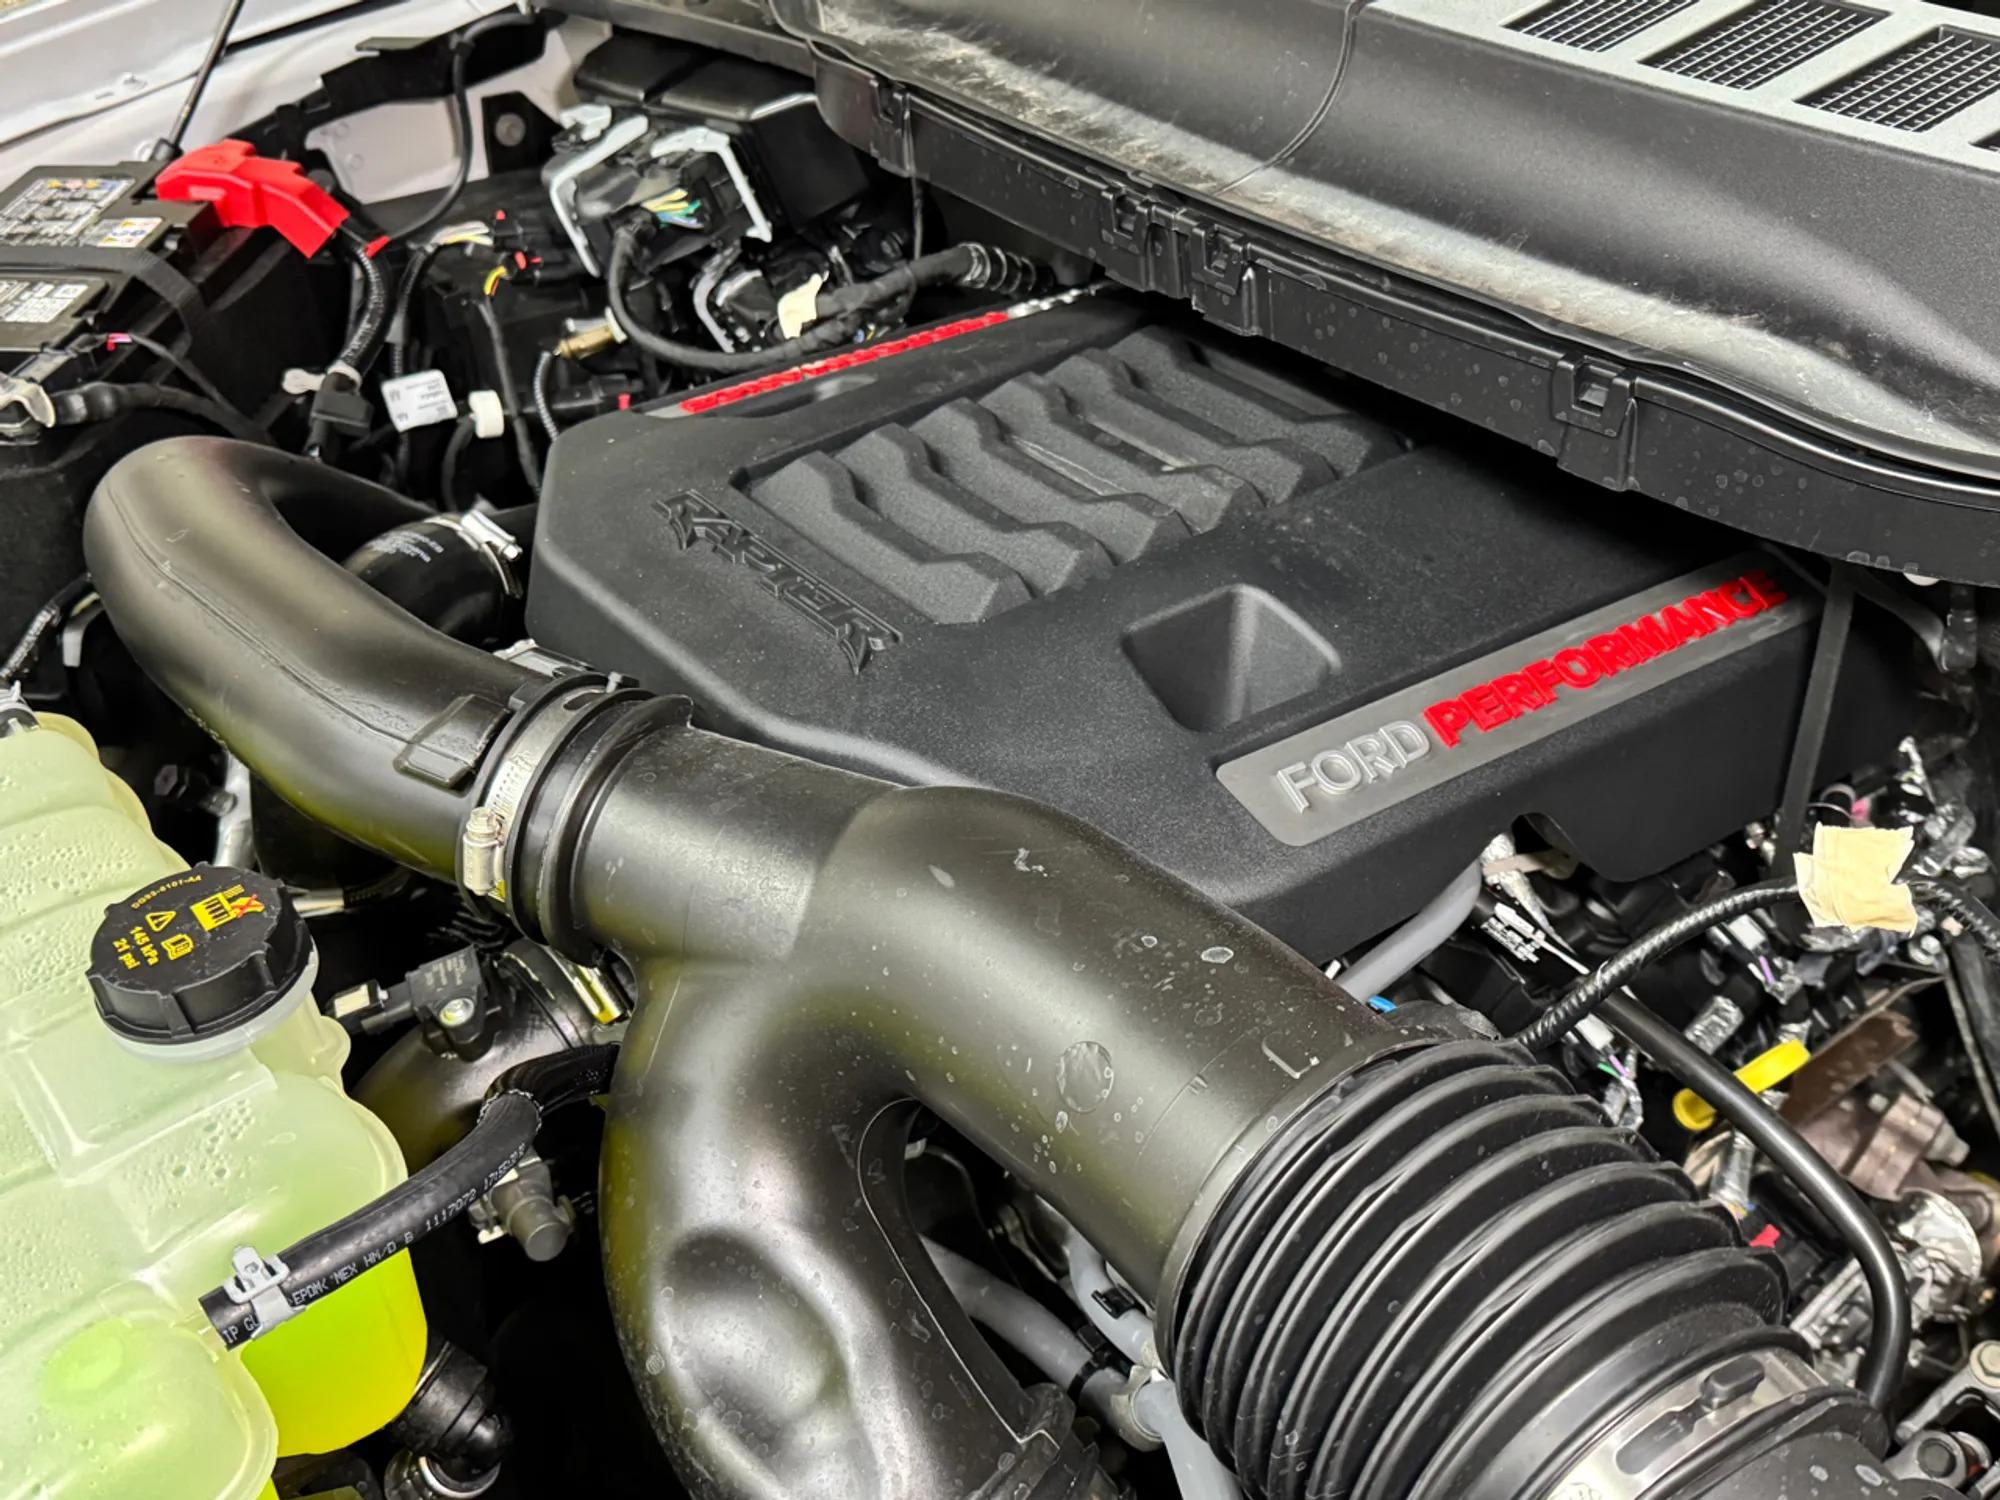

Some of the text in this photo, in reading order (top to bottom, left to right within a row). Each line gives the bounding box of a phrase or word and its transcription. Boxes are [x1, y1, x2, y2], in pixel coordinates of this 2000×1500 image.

[1275, 570, 1788, 814] FORD PERFORMANCE
[112, 938, 141, 970] 21 psi
[129, 926, 160, 966] 145 kPa
